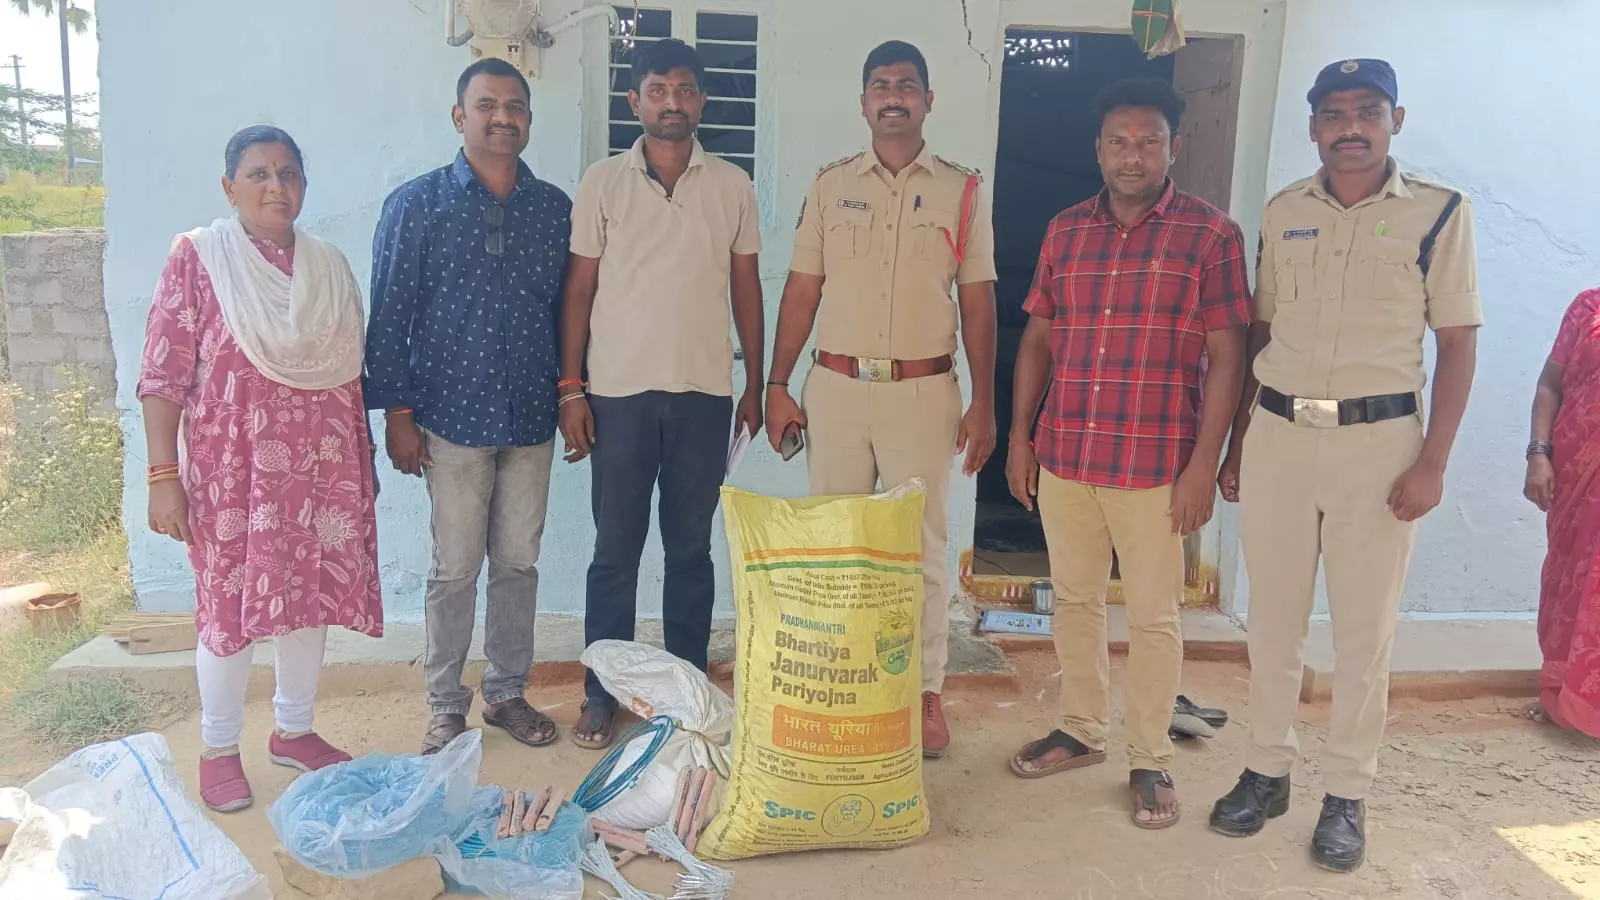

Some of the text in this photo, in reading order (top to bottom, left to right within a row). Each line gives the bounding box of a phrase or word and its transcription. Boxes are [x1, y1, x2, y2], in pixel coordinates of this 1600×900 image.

[780, 613, 846, 635] PRADHANMANTRI
[775, 630, 851, 662] Bhartiya
[770, 651, 879, 684] Janurvarak
[771, 674, 857, 708] Pariyojna
[782, 713, 822, 734] भारत
[827, 719, 871, 740] यूरिया
[785, 737, 865, 753] BHARAT UREA
[765, 800, 817, 821] SPIC
[882, 794, 919, 820] SPIC
